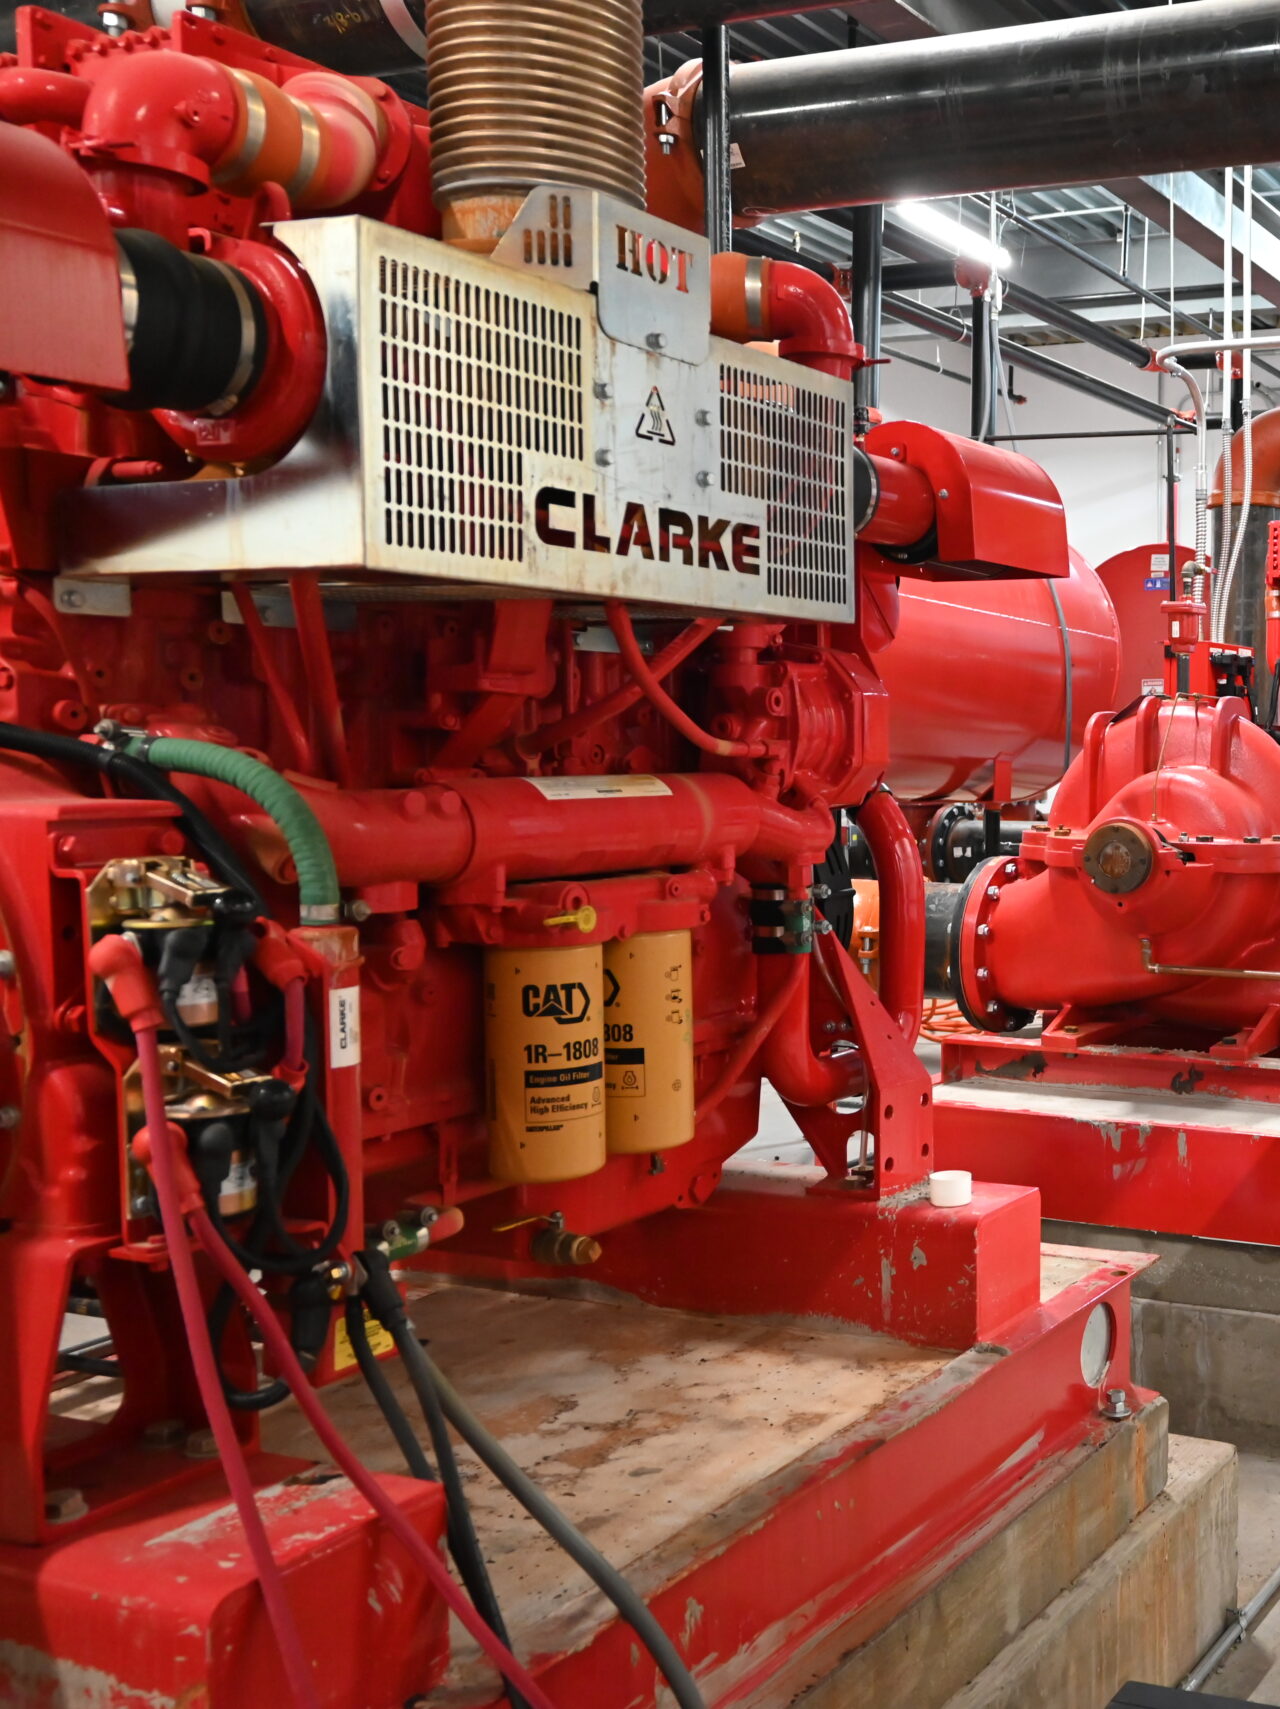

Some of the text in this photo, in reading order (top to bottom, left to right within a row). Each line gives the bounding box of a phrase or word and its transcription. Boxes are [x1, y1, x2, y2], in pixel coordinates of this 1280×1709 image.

[616, 224, 694, 294] HOT
[535, 486, 761, 576] CLARKE
[522, 982, 578, 1017] CAT
[339, 1000, 347, 1049] CLARKE
[524, 1037, 599, 1064] 1R-1808
[560, 1073, 571, 1082] Oil
[572, 1071, 590, 1081] Filter
[530, 1094, 570, 1104] Advanced
[530, 1102, 588, 1115] High Efficiency
